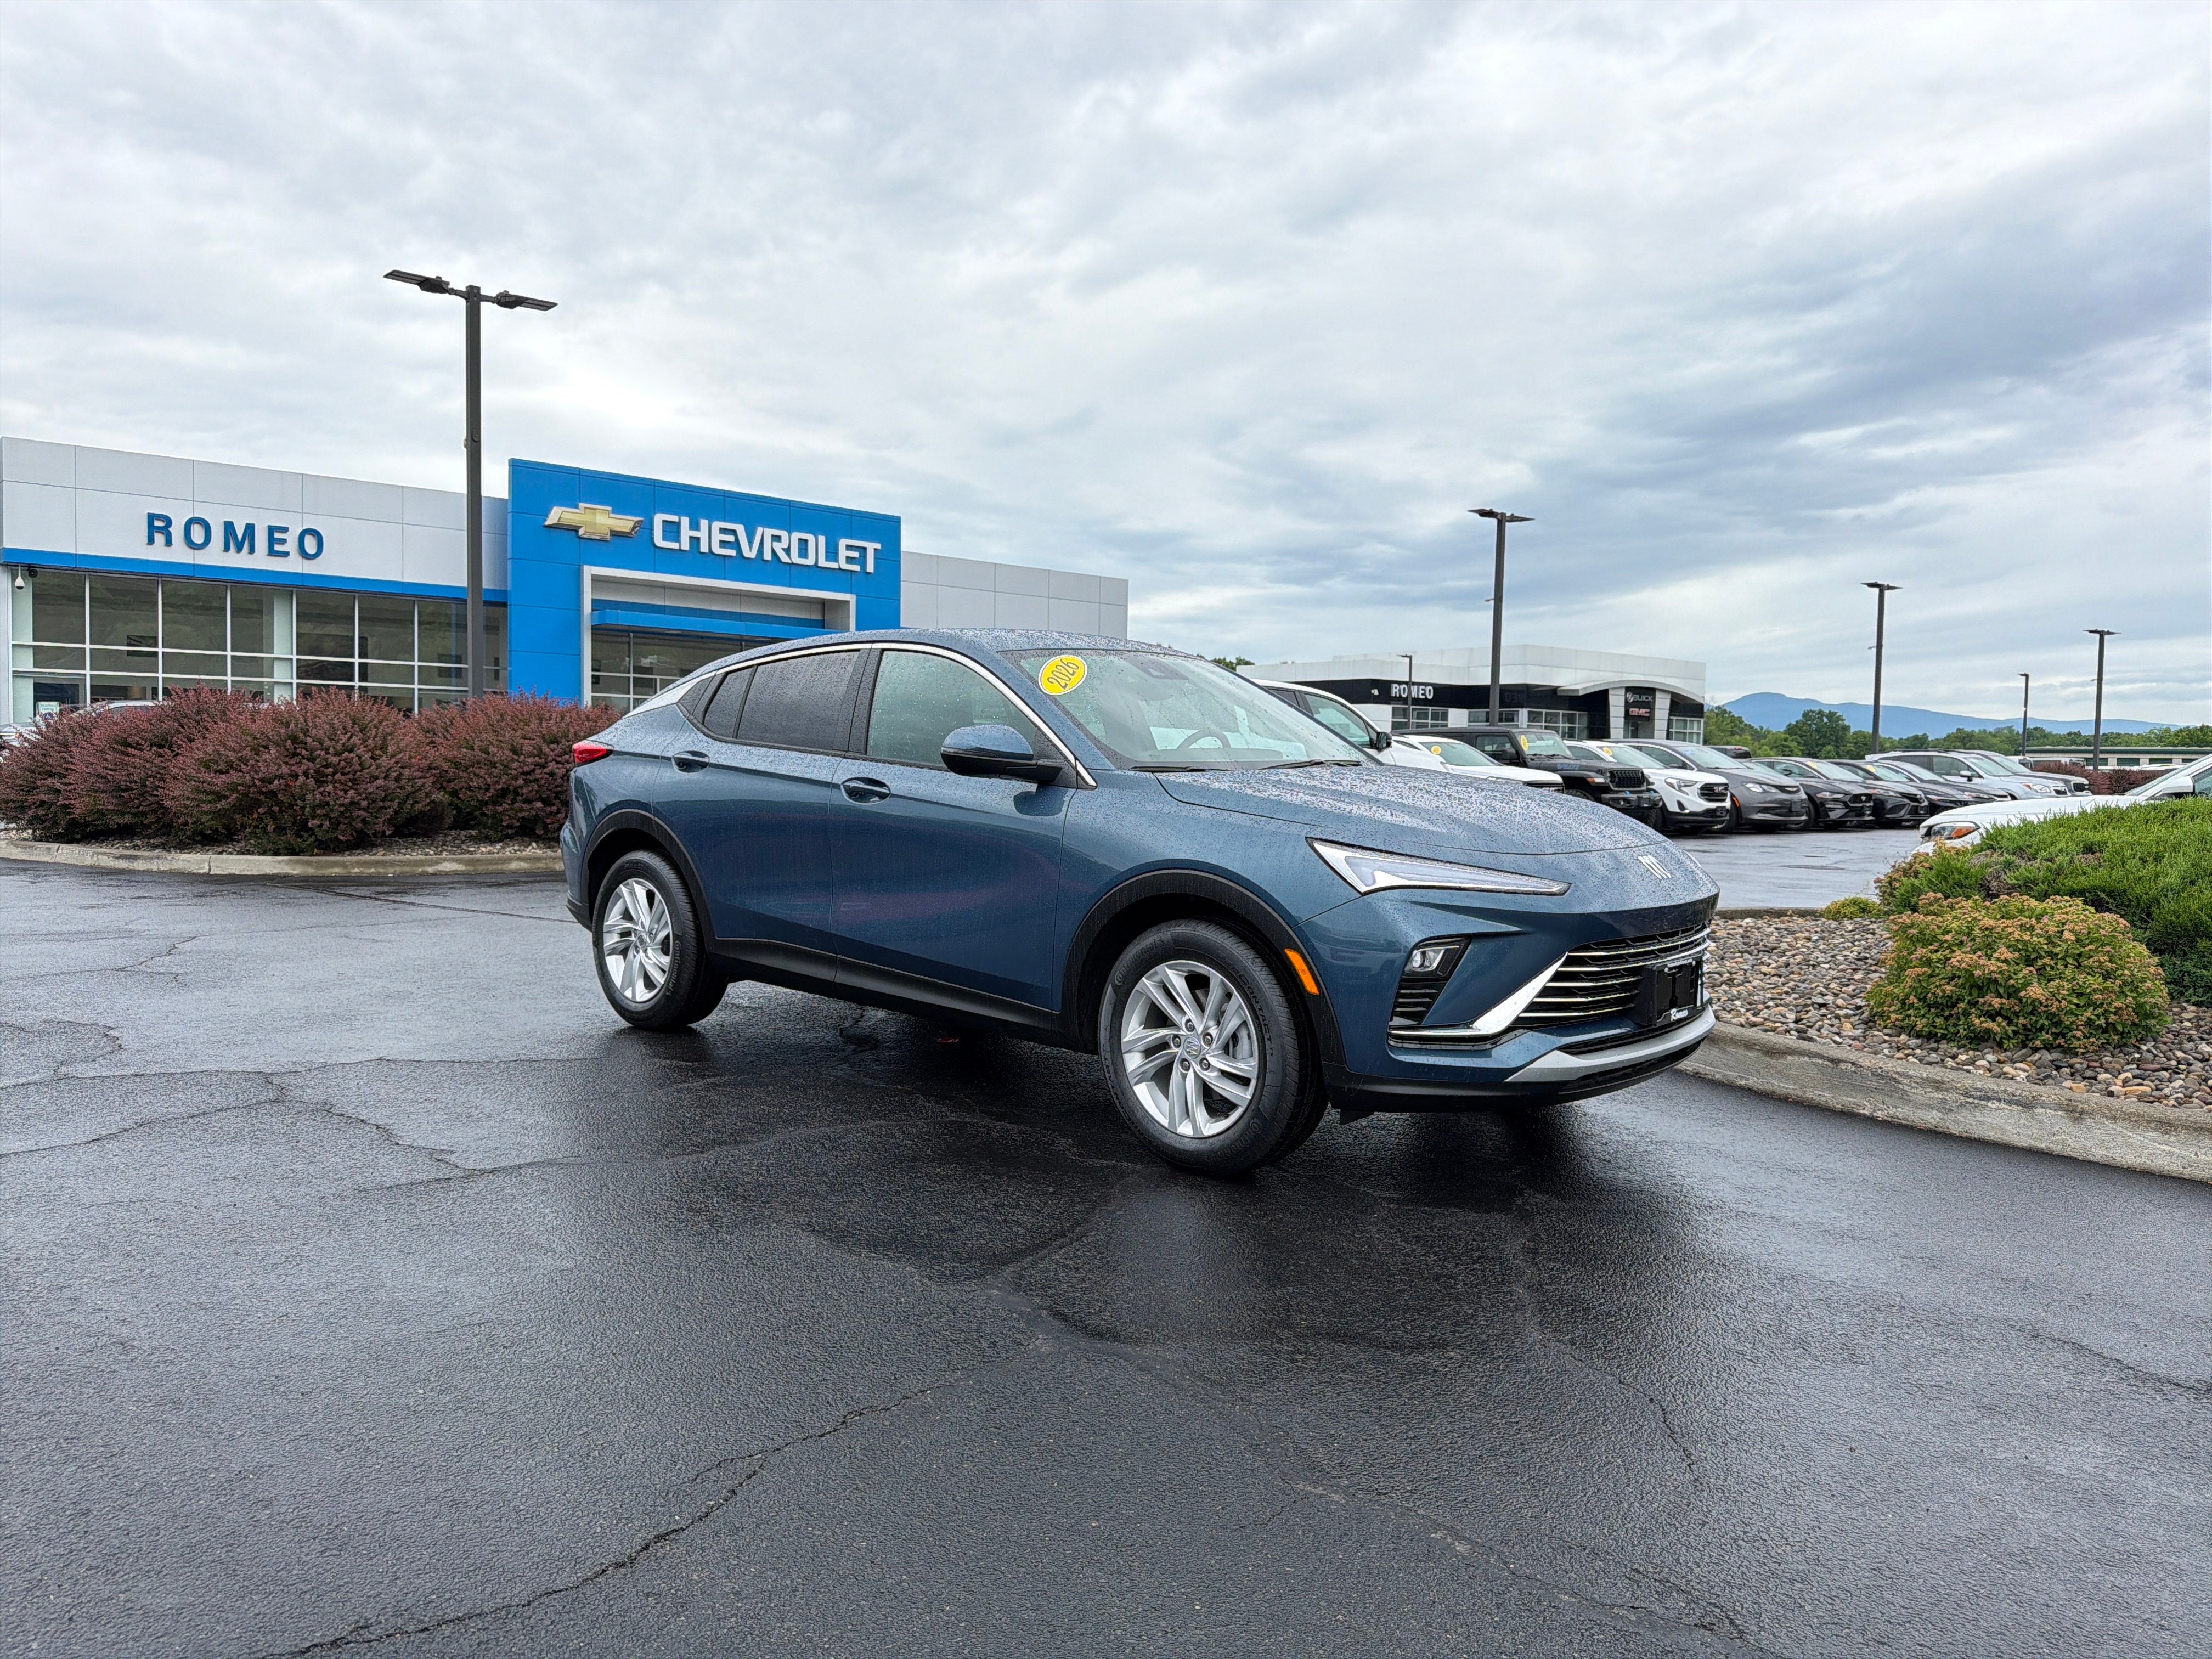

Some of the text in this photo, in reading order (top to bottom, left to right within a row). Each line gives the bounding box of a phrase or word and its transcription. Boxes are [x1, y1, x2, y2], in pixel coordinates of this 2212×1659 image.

[146, 512, 324, 560] ROMEO
[653, 513, 881, 573] CHEVROLET
[1047, 658, 1079, 690] 2026
[1391, 684, 1434, 699] ROMEO
[1633, 694, 1654, 702] BUICK
[1629, 708, 1650, 716] GMC
